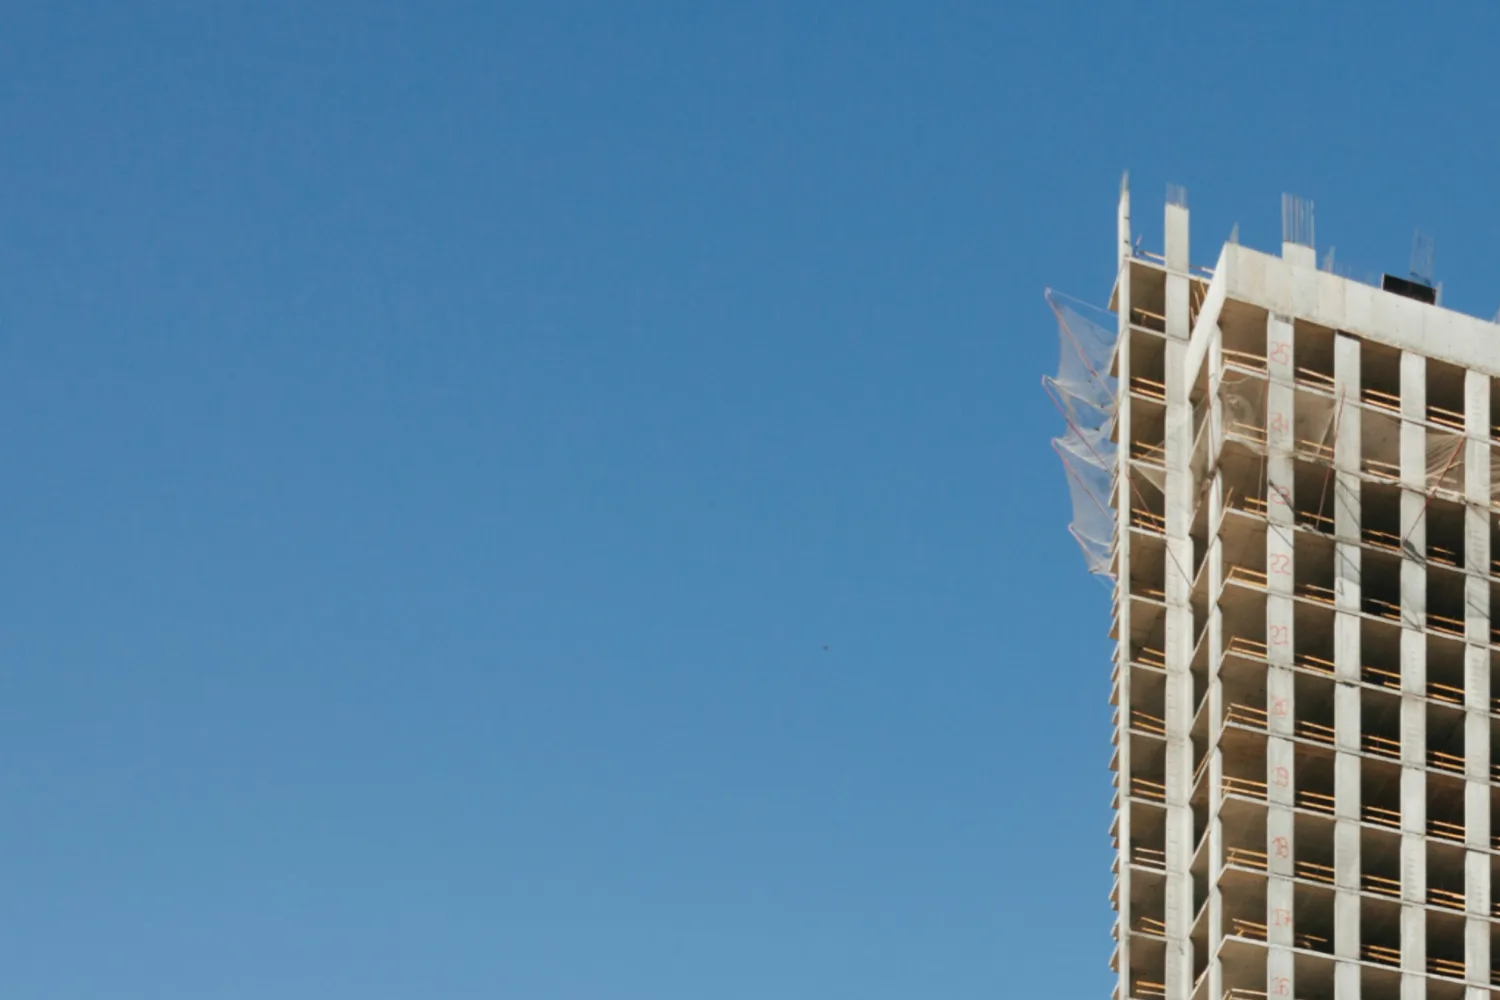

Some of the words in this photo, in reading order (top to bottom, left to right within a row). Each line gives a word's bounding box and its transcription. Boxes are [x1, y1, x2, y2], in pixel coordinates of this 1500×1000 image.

[1270, 341, 1290, 366] 25
[1270, 554, 1291, 575] 22
[1270, 625, 1288, 645] 21
[1272, 836, 1289, 858] 18
